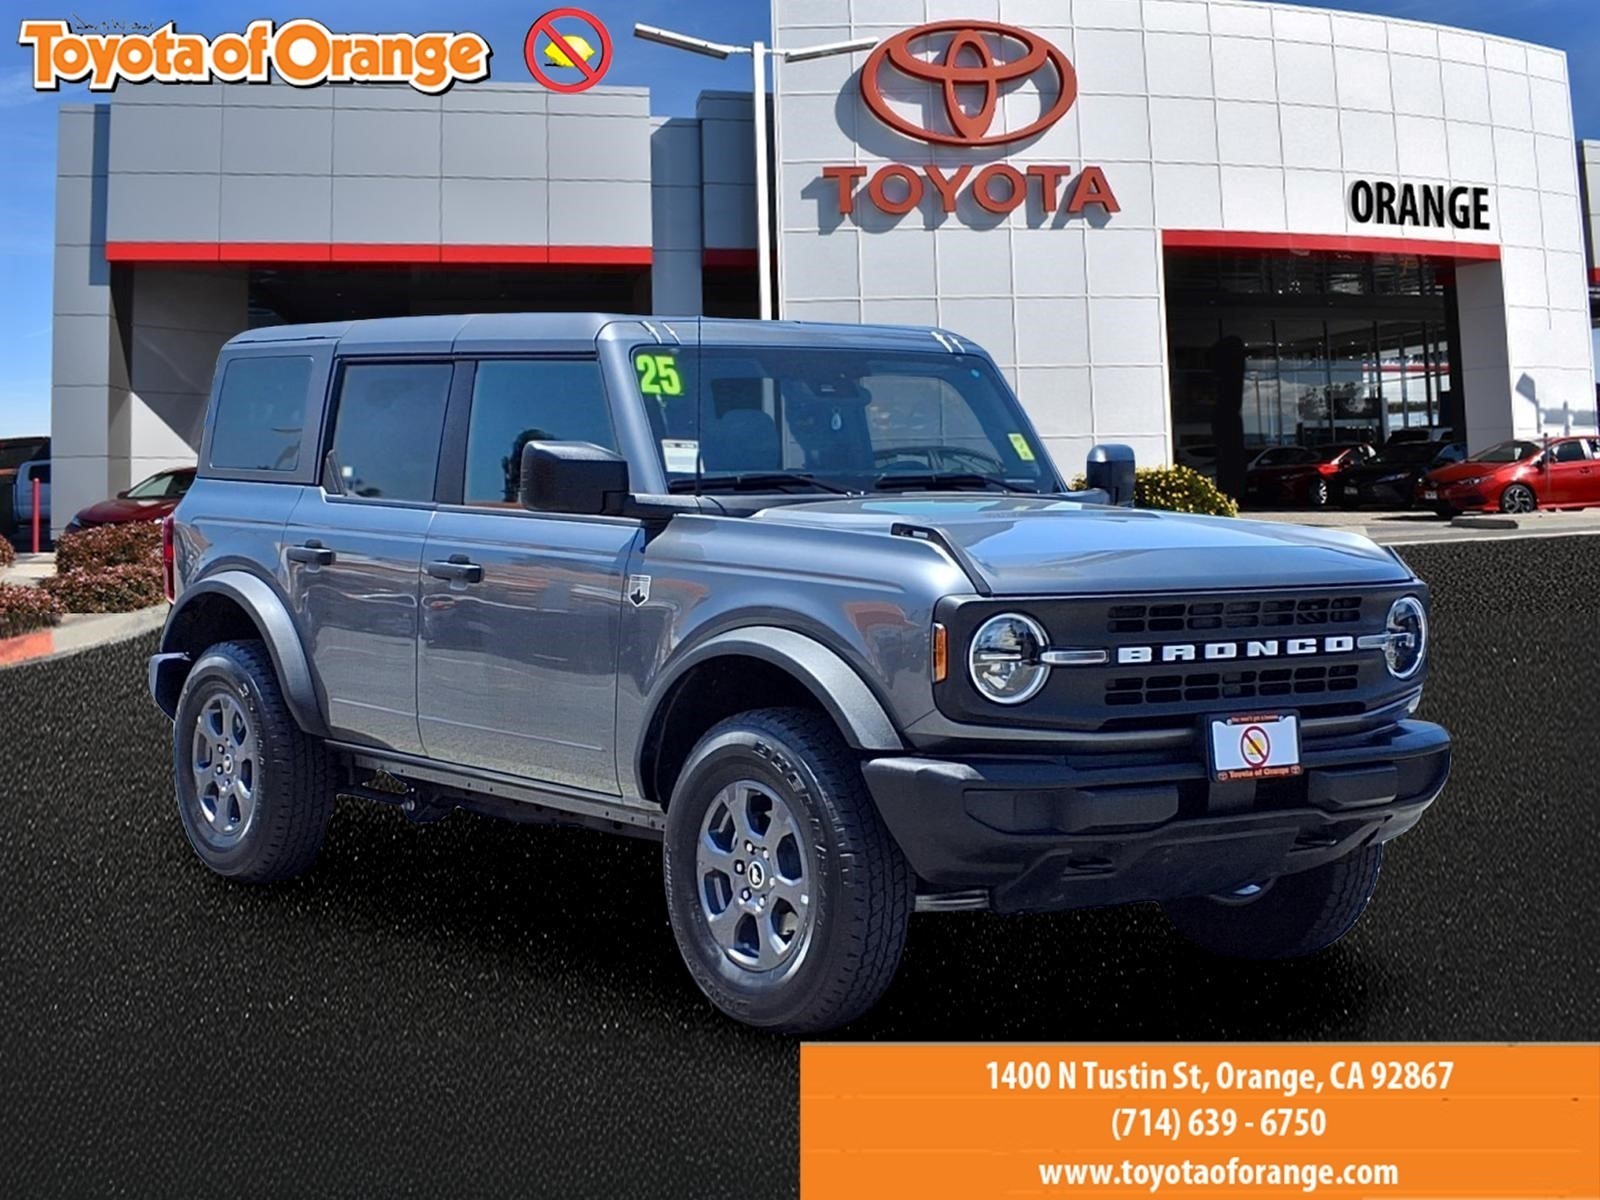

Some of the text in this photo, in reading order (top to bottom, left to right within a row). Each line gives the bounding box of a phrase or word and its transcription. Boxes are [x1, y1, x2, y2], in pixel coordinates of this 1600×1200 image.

[823, 164, 1120, 215] TOYOTA
[1350, 180, 1490, 231] ORANGE
[635, 353, 683, 397] 25
[1117, 635, 1355, 665] BRONCO
